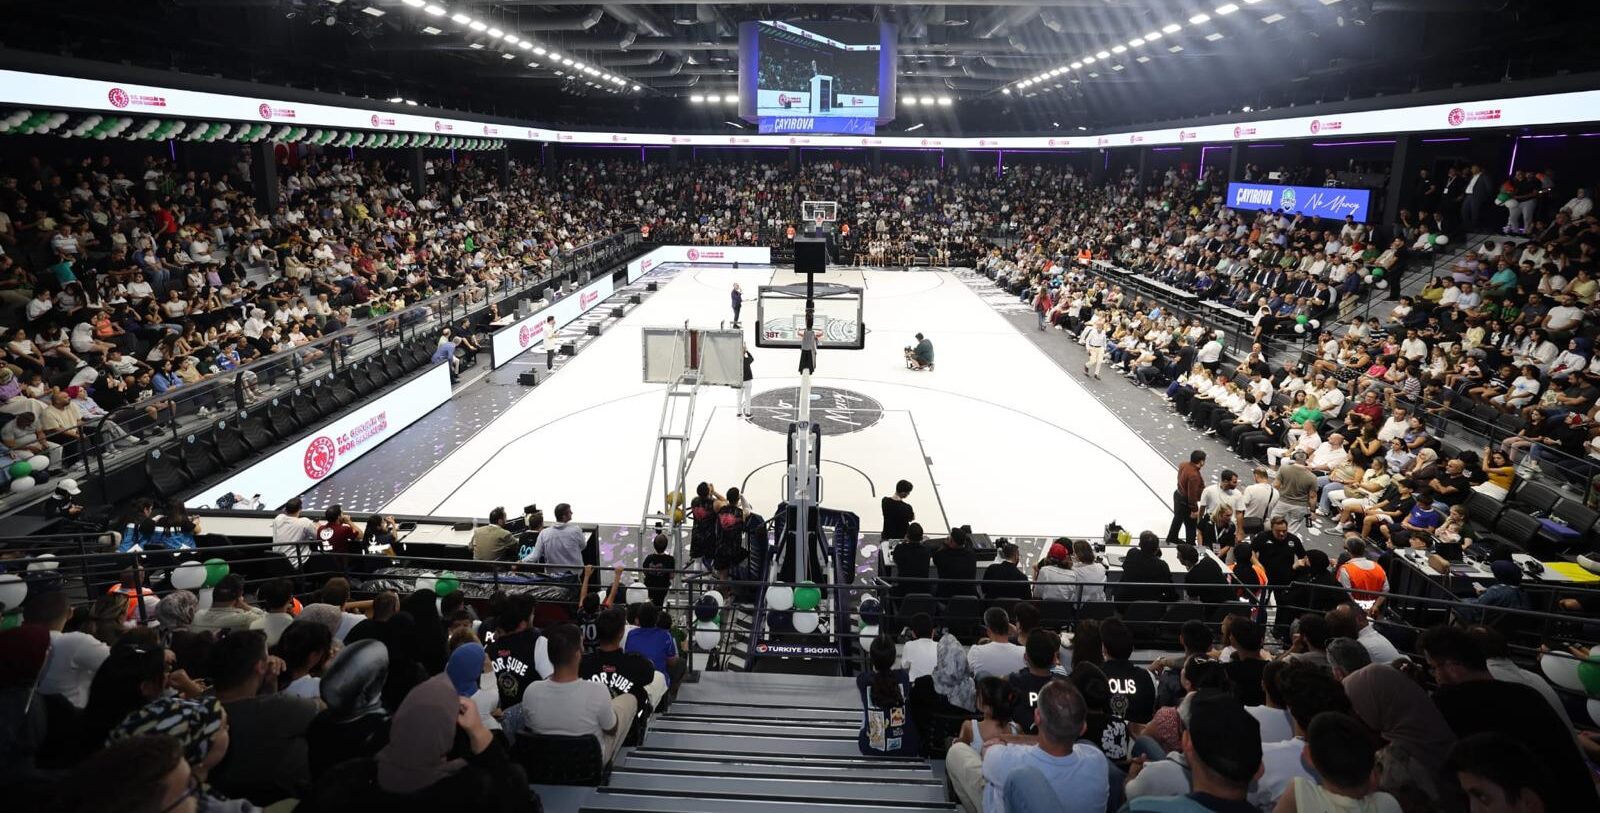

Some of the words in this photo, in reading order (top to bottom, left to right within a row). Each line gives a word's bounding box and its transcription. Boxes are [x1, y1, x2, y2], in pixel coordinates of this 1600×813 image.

[774, 117, 815, 133] ÇAYIROVA
[1236, 187, 1274, 206] ÇAYIROVA
[1304, 193, 1323, 210] No
[491, 657, 506, 673] OR
[506, 656, 529, 676] ŞUBE
[610, 673, 634, 693] ŞUBE
[1108, 678, 1137, 695] OLIS
